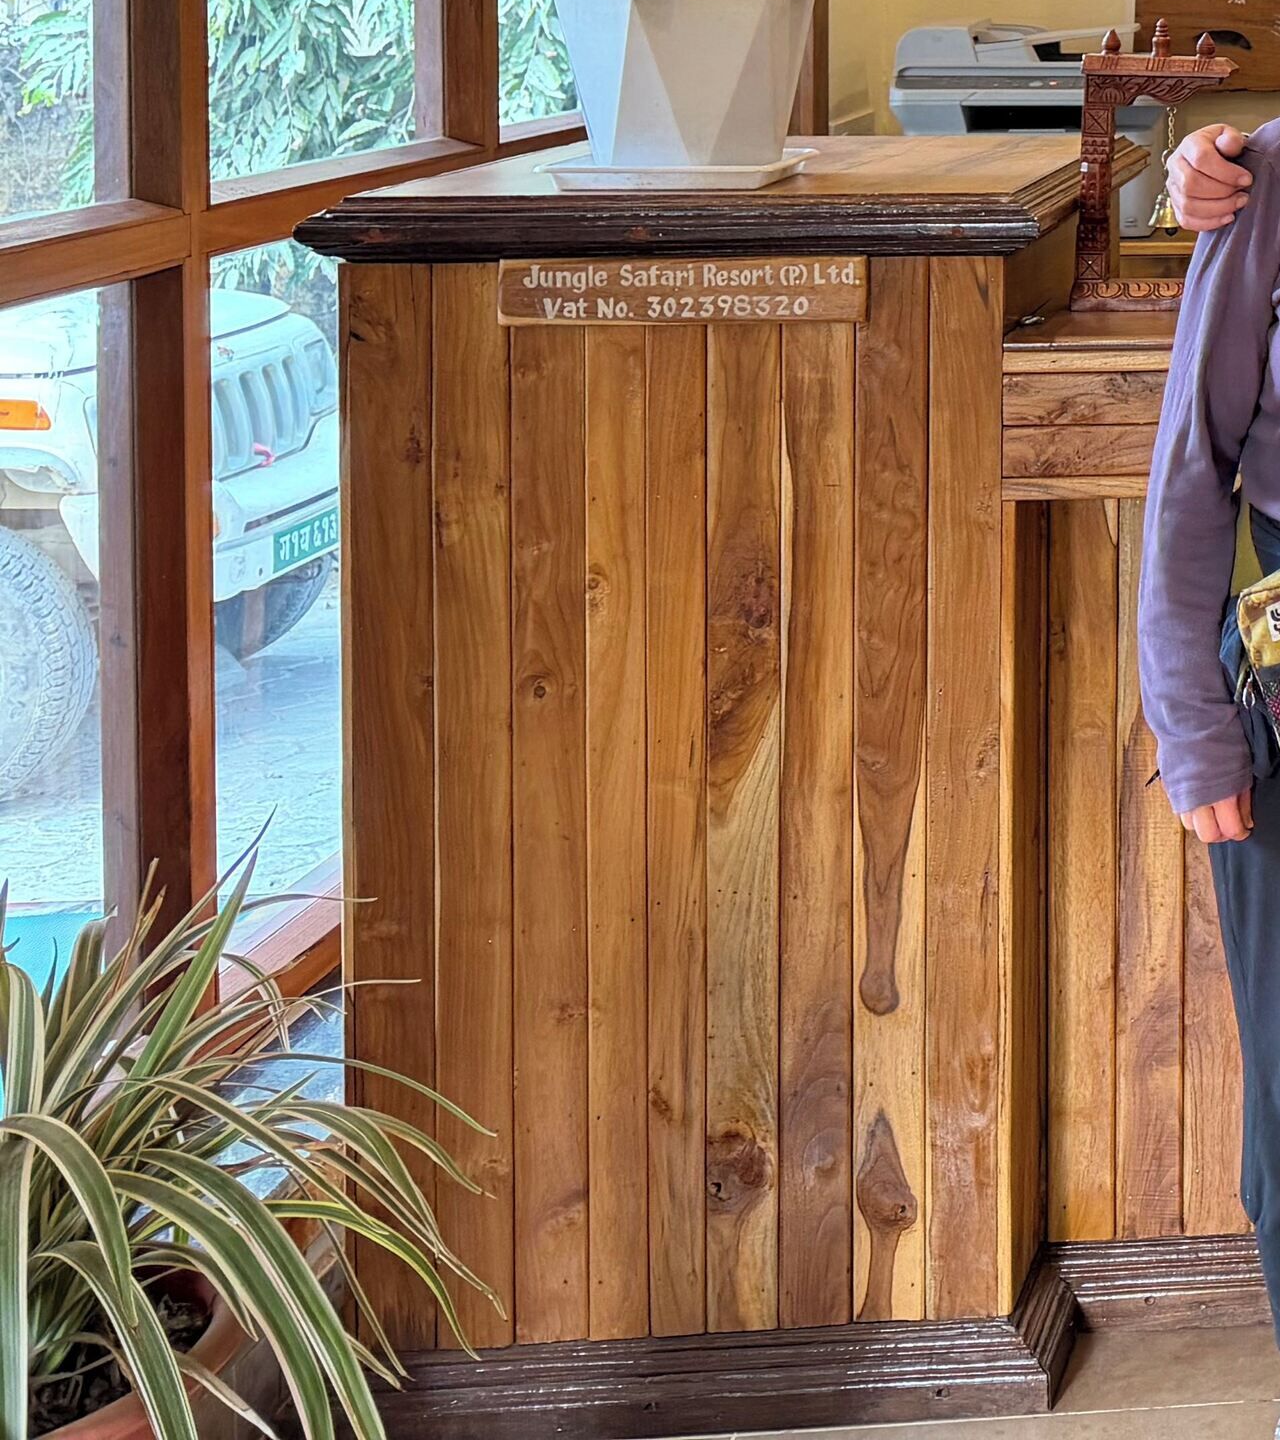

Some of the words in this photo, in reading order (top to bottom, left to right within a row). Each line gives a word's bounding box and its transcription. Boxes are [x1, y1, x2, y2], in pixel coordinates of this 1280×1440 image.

[523, 264, 608, 294] Jungle
[619, 263, 695, 288] Safari
[703, 264, 775, 287] Resort
[814, 262, 861, 286] Ltd.
[542, 295, 588, 320] Vat
[597, 296, 635, 320] No.
[647, 294, 810, 318] 302398320
